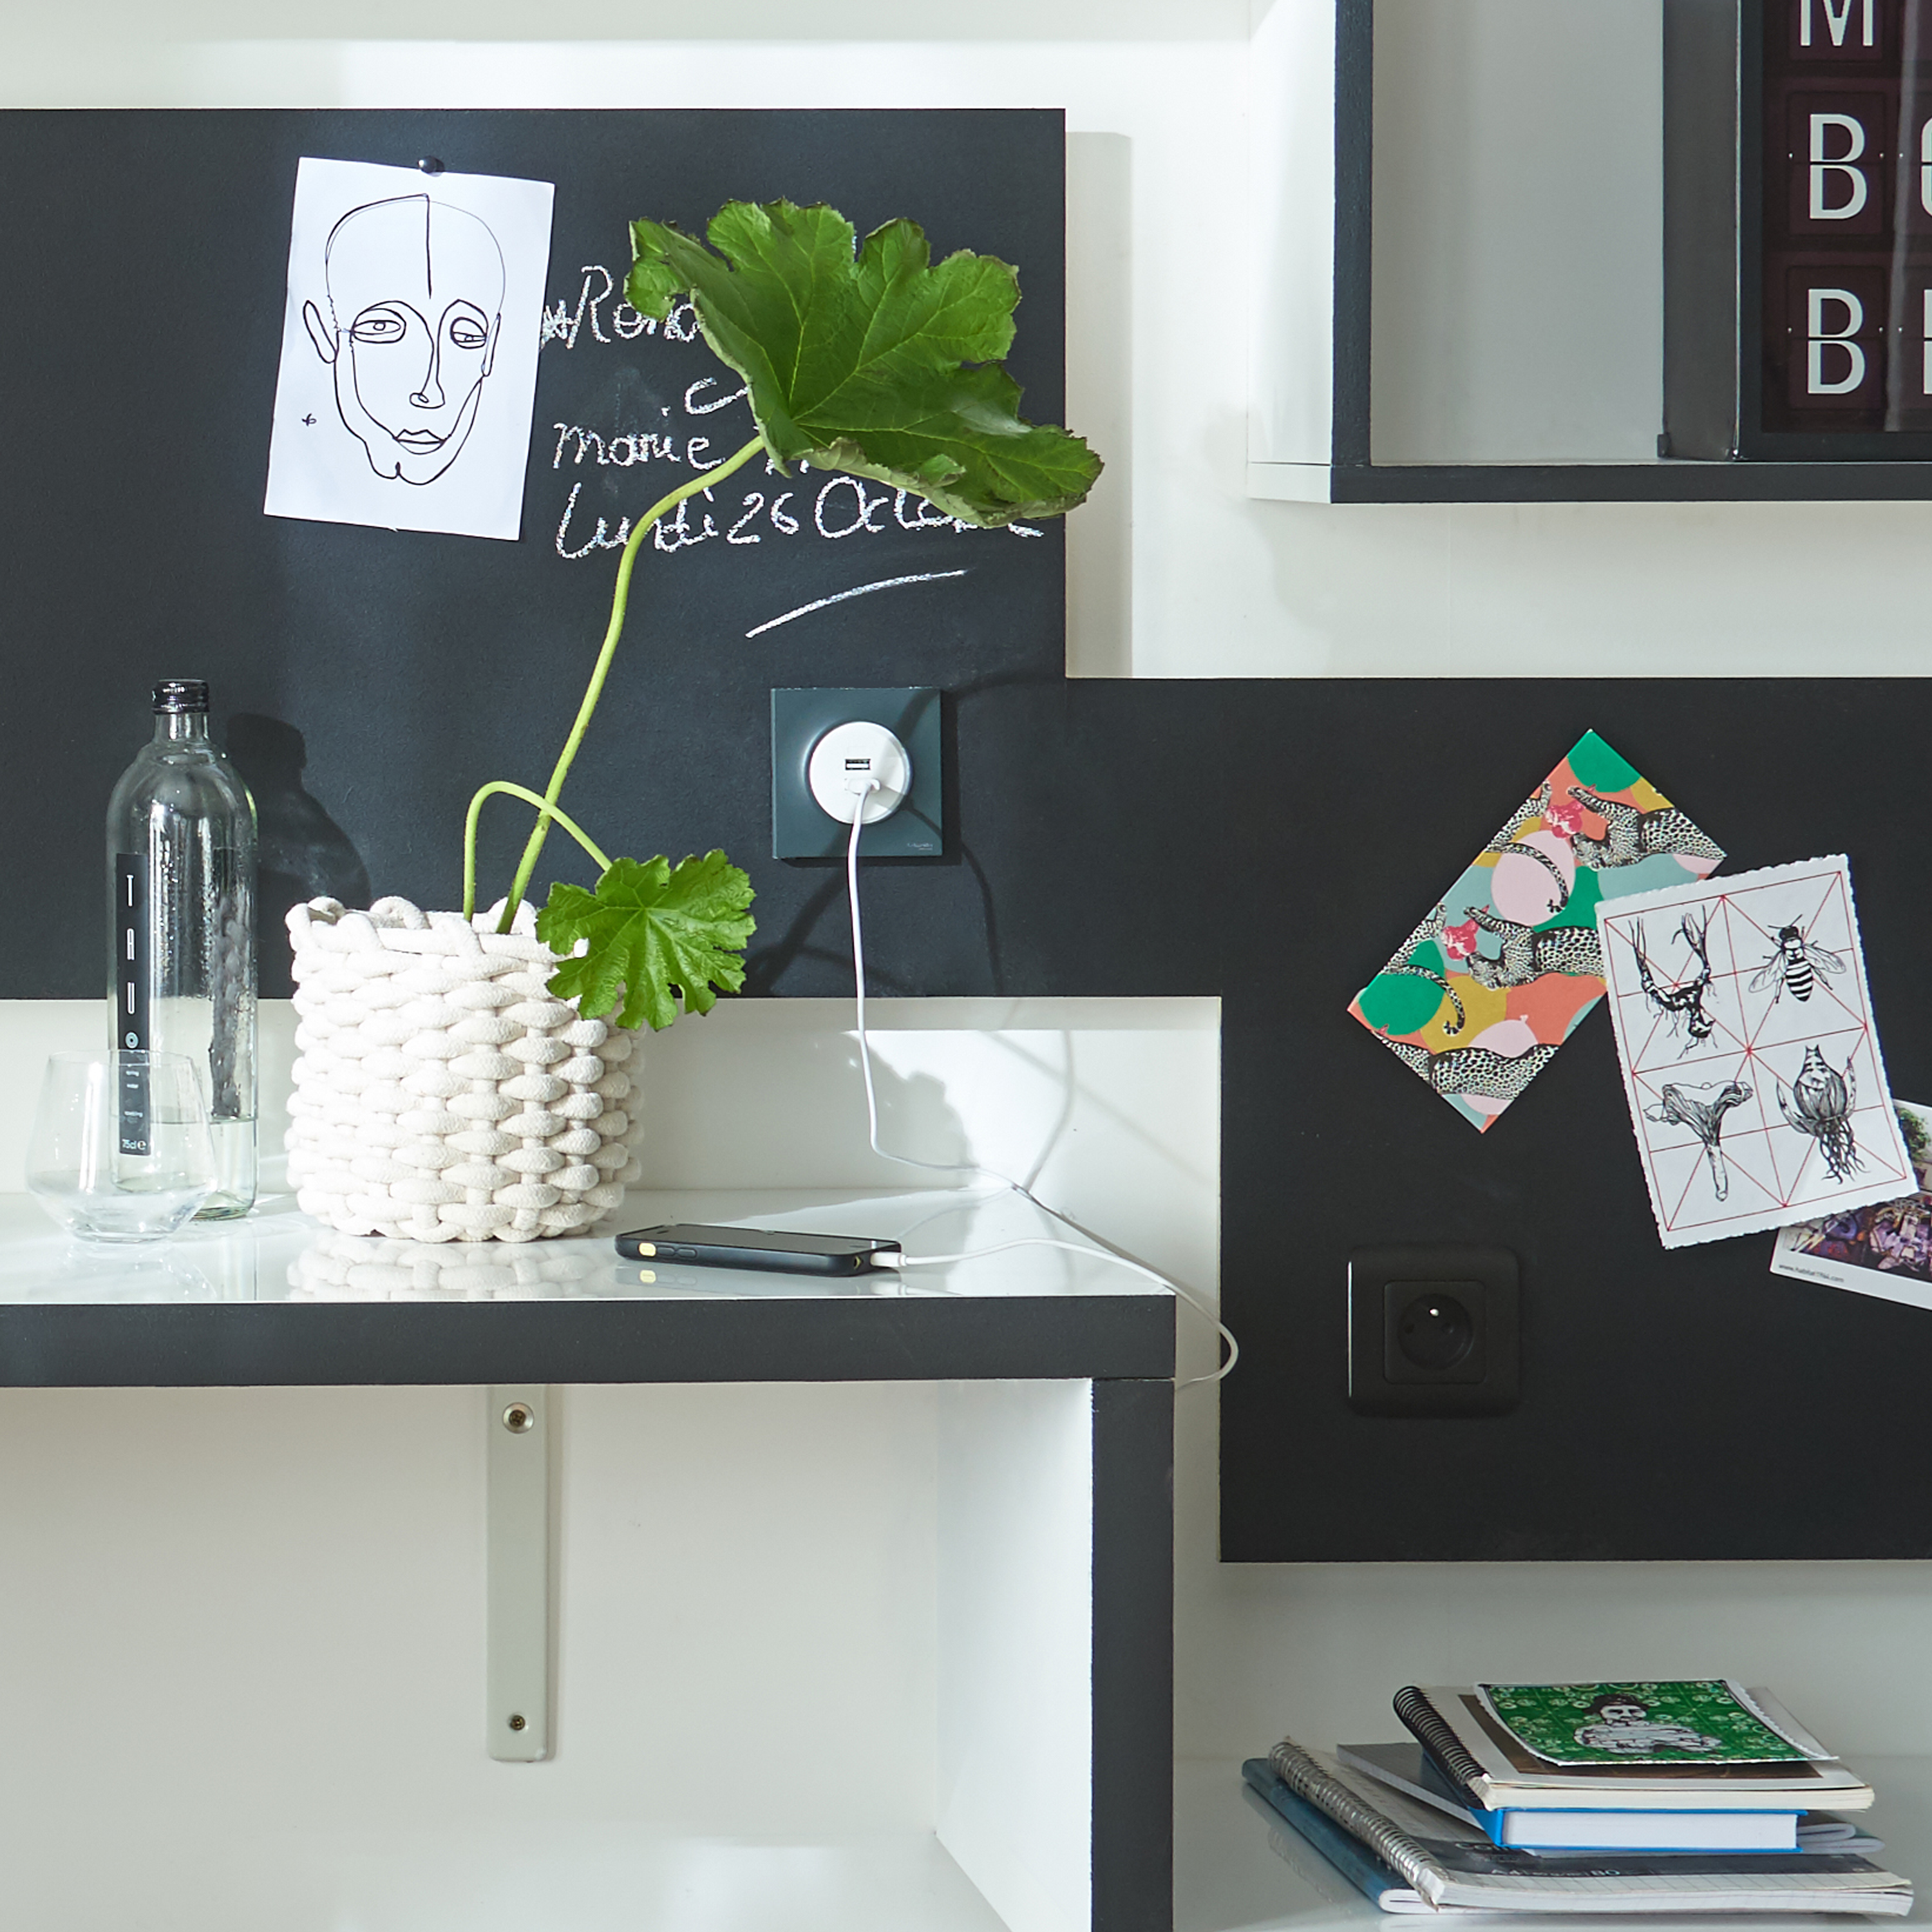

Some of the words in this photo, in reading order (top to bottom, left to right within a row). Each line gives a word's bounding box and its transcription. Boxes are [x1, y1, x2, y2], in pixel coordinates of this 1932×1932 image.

[1809, 113, 1932, 220] B
[1807, 288, 1932, 395] B
[726, 492, 800, 545] 26
